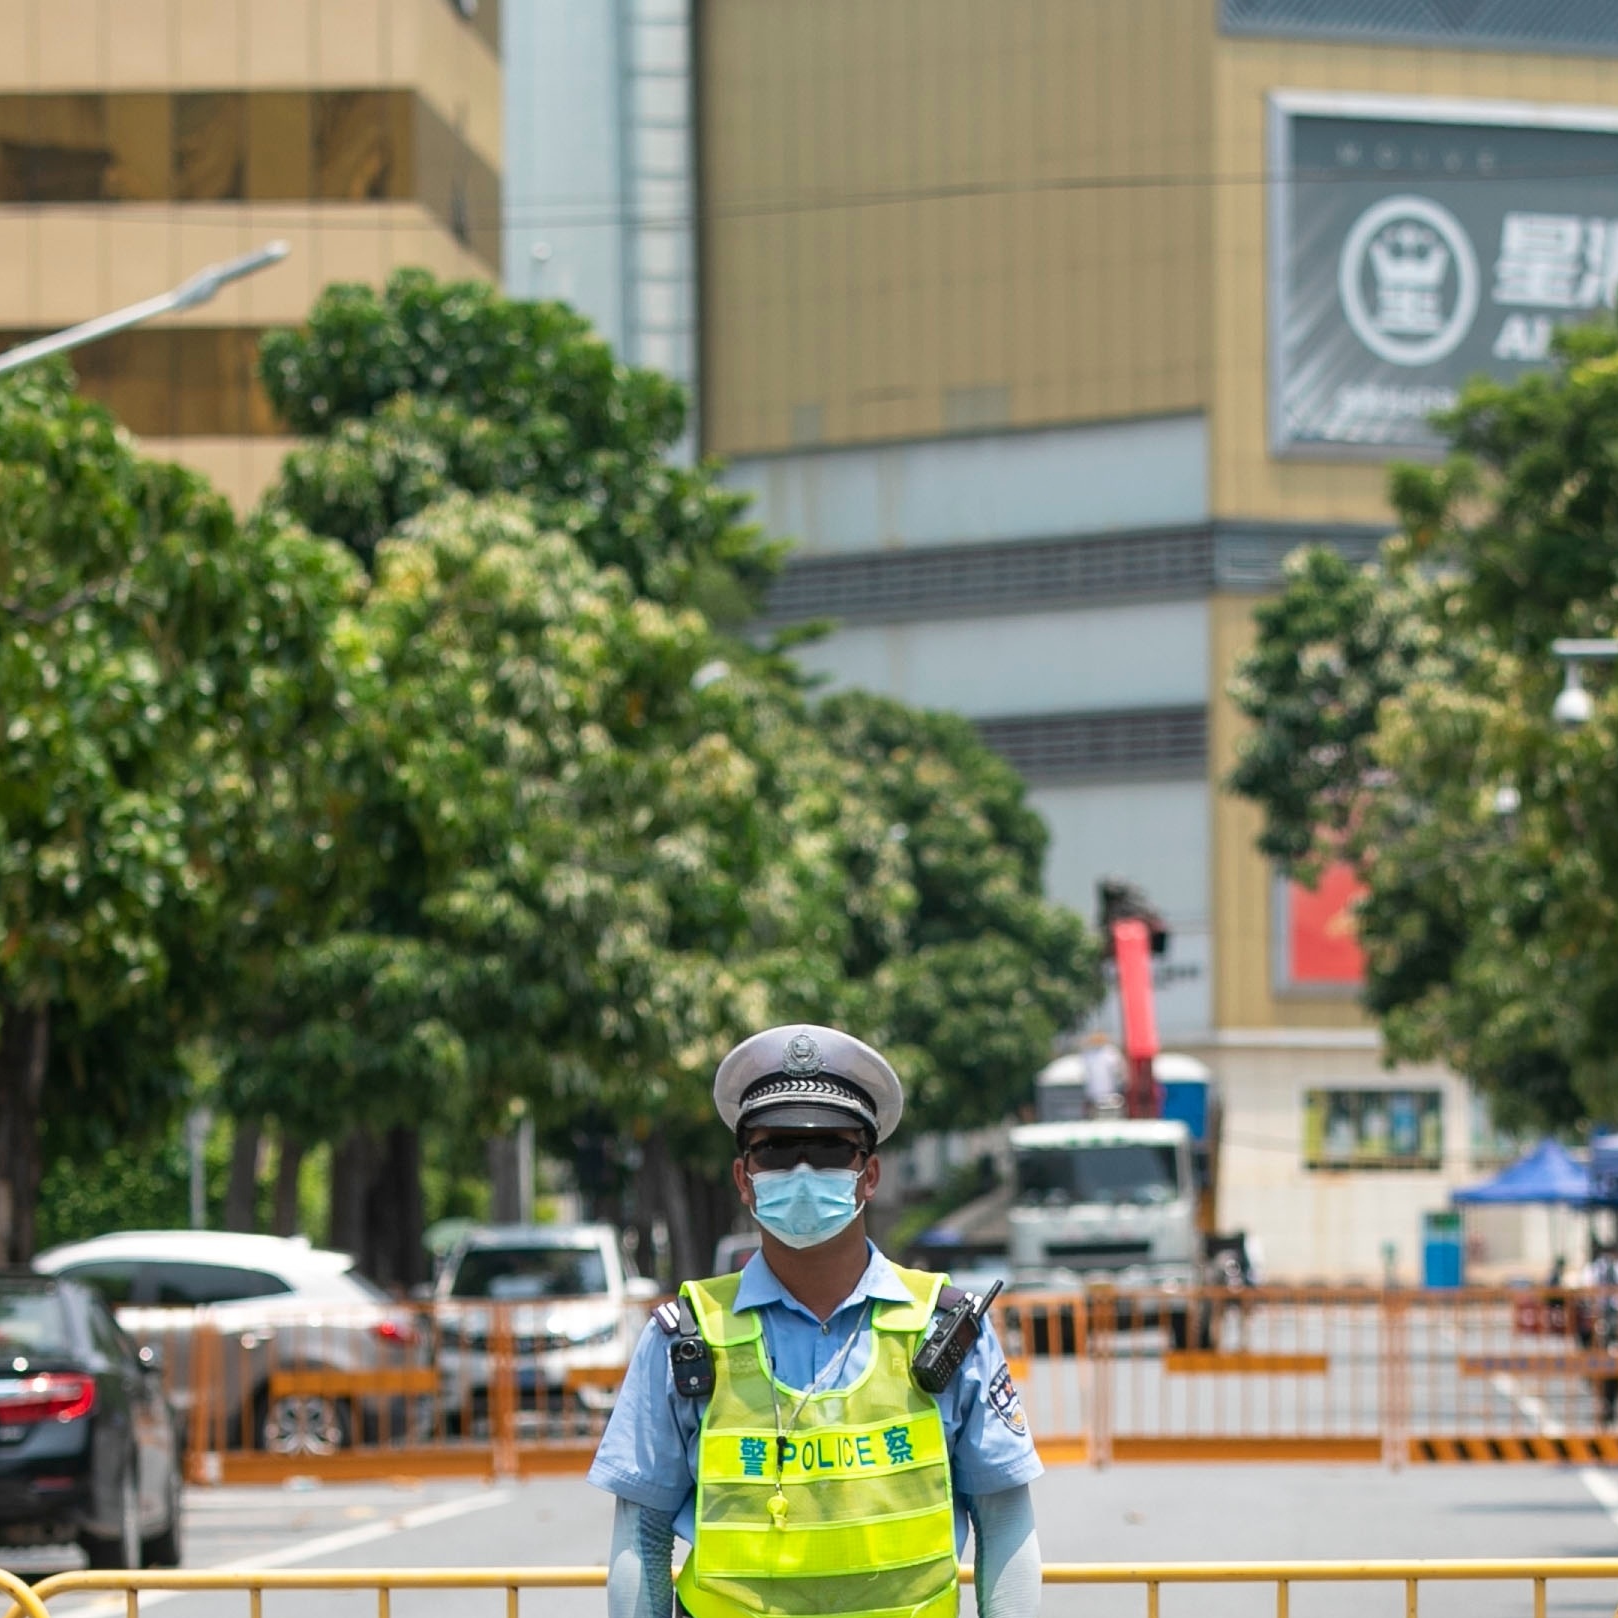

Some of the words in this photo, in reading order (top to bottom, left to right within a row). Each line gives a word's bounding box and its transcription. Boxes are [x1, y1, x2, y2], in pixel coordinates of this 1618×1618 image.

[739, 1436, 767, 1477] 警
[780, 1436, 877, 1472] POLICE
[883, 1426, 914, 1466] 察
